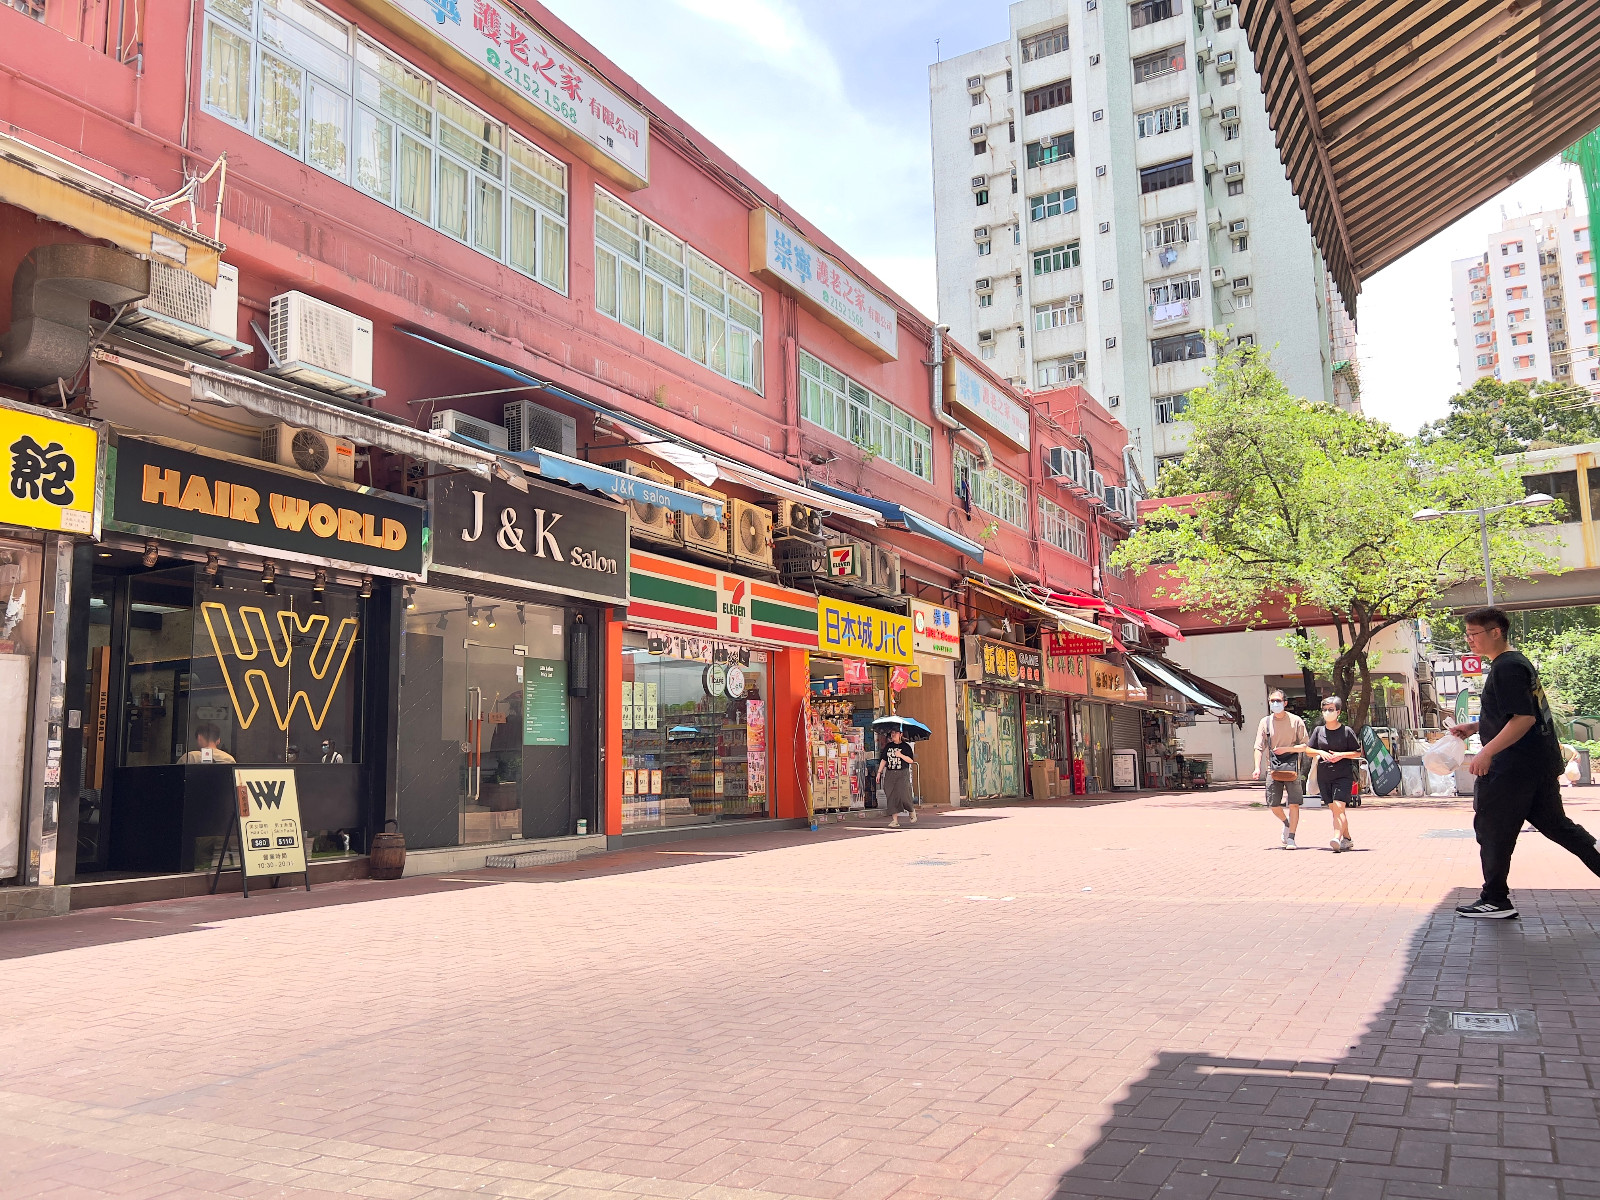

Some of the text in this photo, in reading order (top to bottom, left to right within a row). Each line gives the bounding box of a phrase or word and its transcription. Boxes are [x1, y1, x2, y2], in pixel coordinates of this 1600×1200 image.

[504, 59, 578, 124] 2152 1568
[588, 97, 639, 147] 有限公司
[830, 296, 847, 317] 2152
[141, 464, 408, 551] HAIR WORLD
[611, 479, 671, 507] J&K salon
[461, 490, 618, 575] J & K Salon
[825, 607, 874, 650] 日本城
[875, 619, 907, 657] JHC
[98, 713, 106, 741] WORLD
